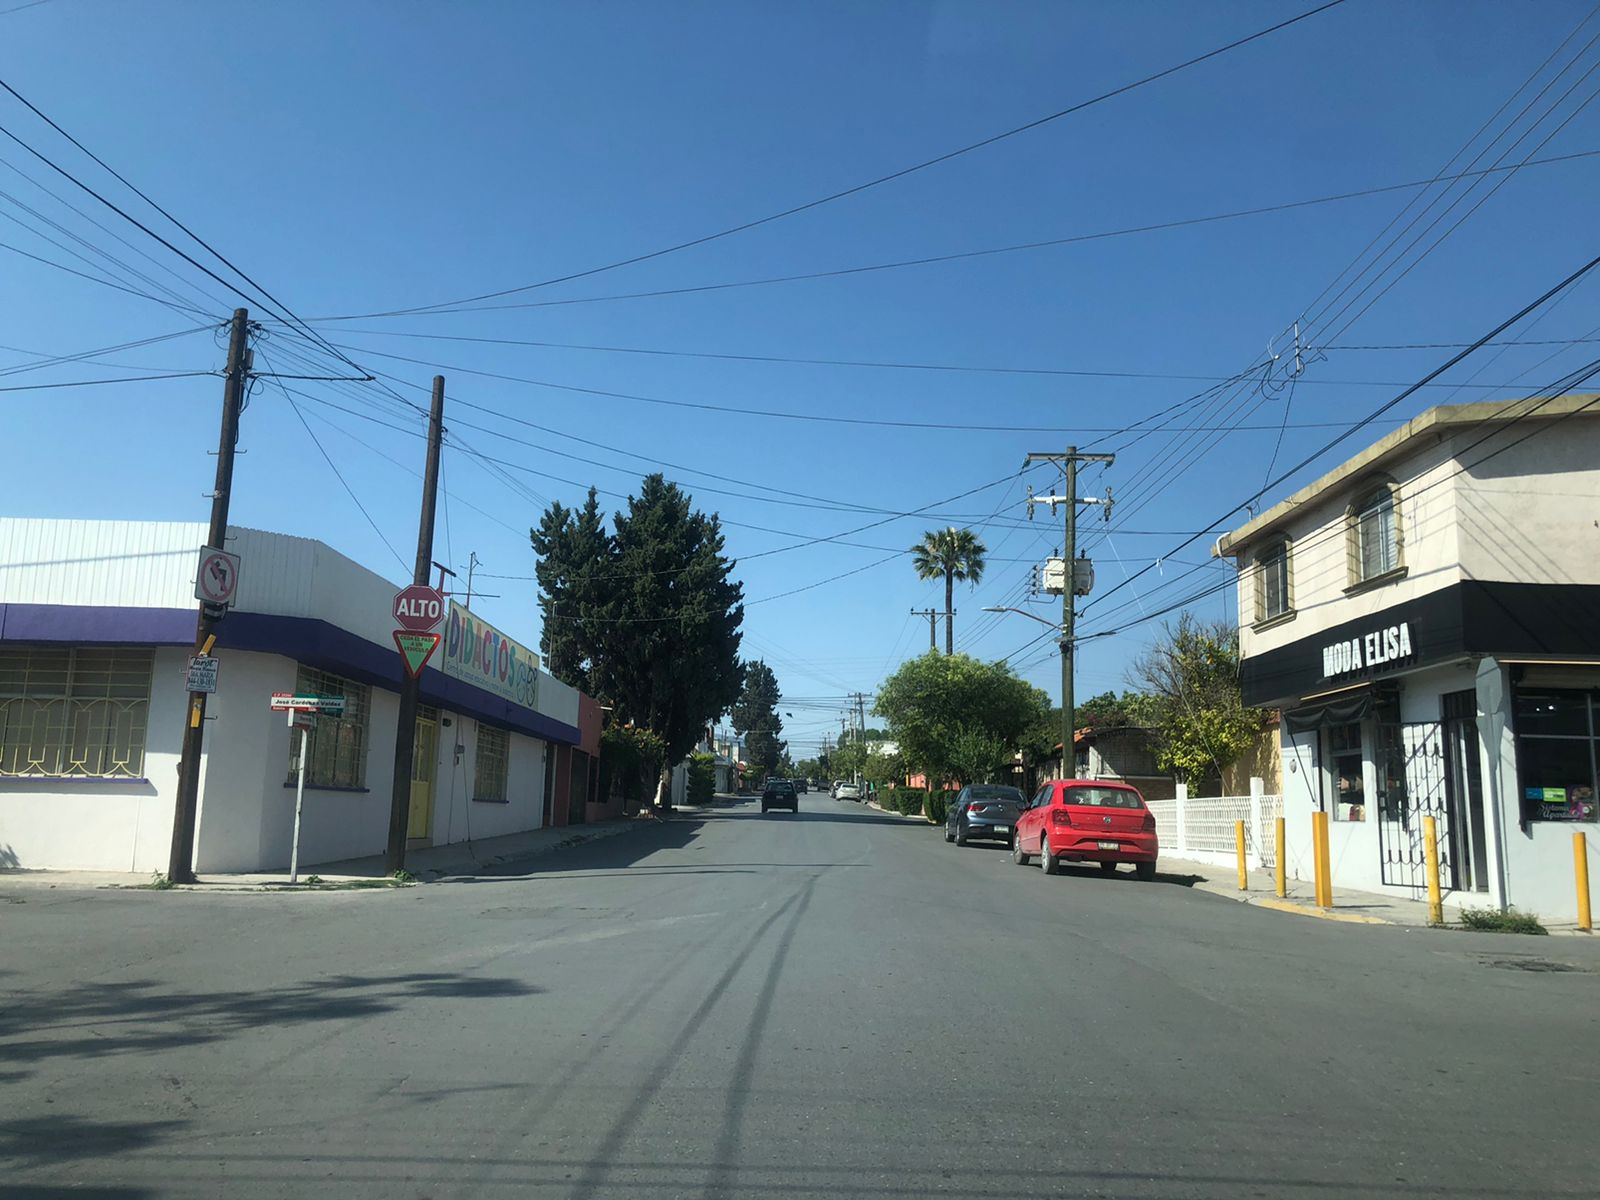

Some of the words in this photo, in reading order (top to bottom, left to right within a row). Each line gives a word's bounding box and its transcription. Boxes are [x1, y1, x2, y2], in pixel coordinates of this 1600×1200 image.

[397, 598, 440, 619] ALTO
[191, 657, 217, 667] Tarot
[448, 607, 516, 688] DIDACTOS
[1323, 638, 1362, 678] MODA
[1365, 622, 1412, 667] ELISA
